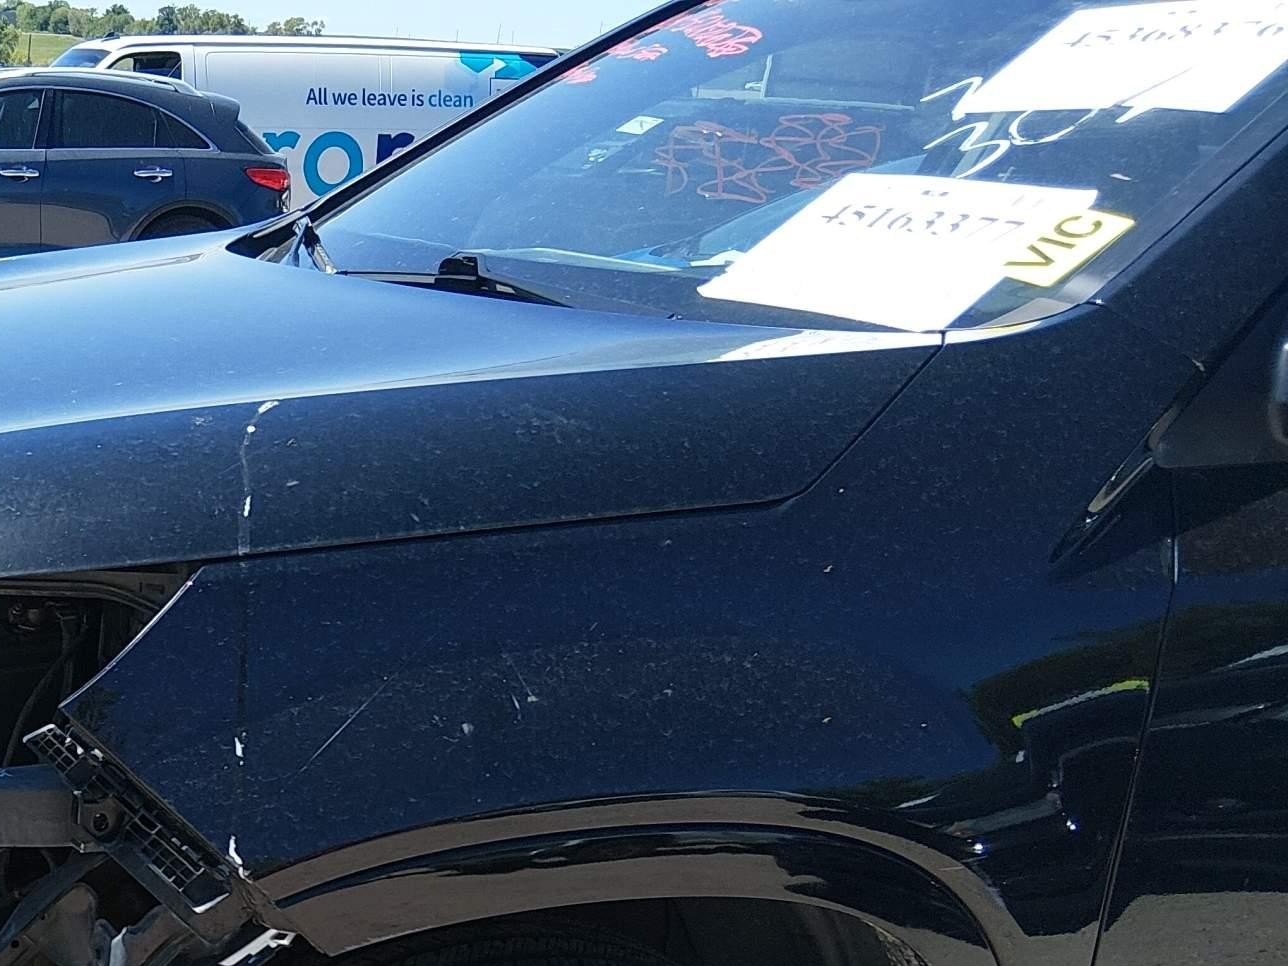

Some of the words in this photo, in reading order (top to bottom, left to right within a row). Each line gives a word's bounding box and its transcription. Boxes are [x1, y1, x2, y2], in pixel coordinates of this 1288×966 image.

[305, 88, 328, 106] All
[332, 92, 357, 107] we
[362, 88, 406, 107] leave
[411, 88, 425, 107] is
[428, 89, 474, 108] clean
[820, 204, 1026, 243] 45163377
[1003, 214, 1104, 268] VIC
